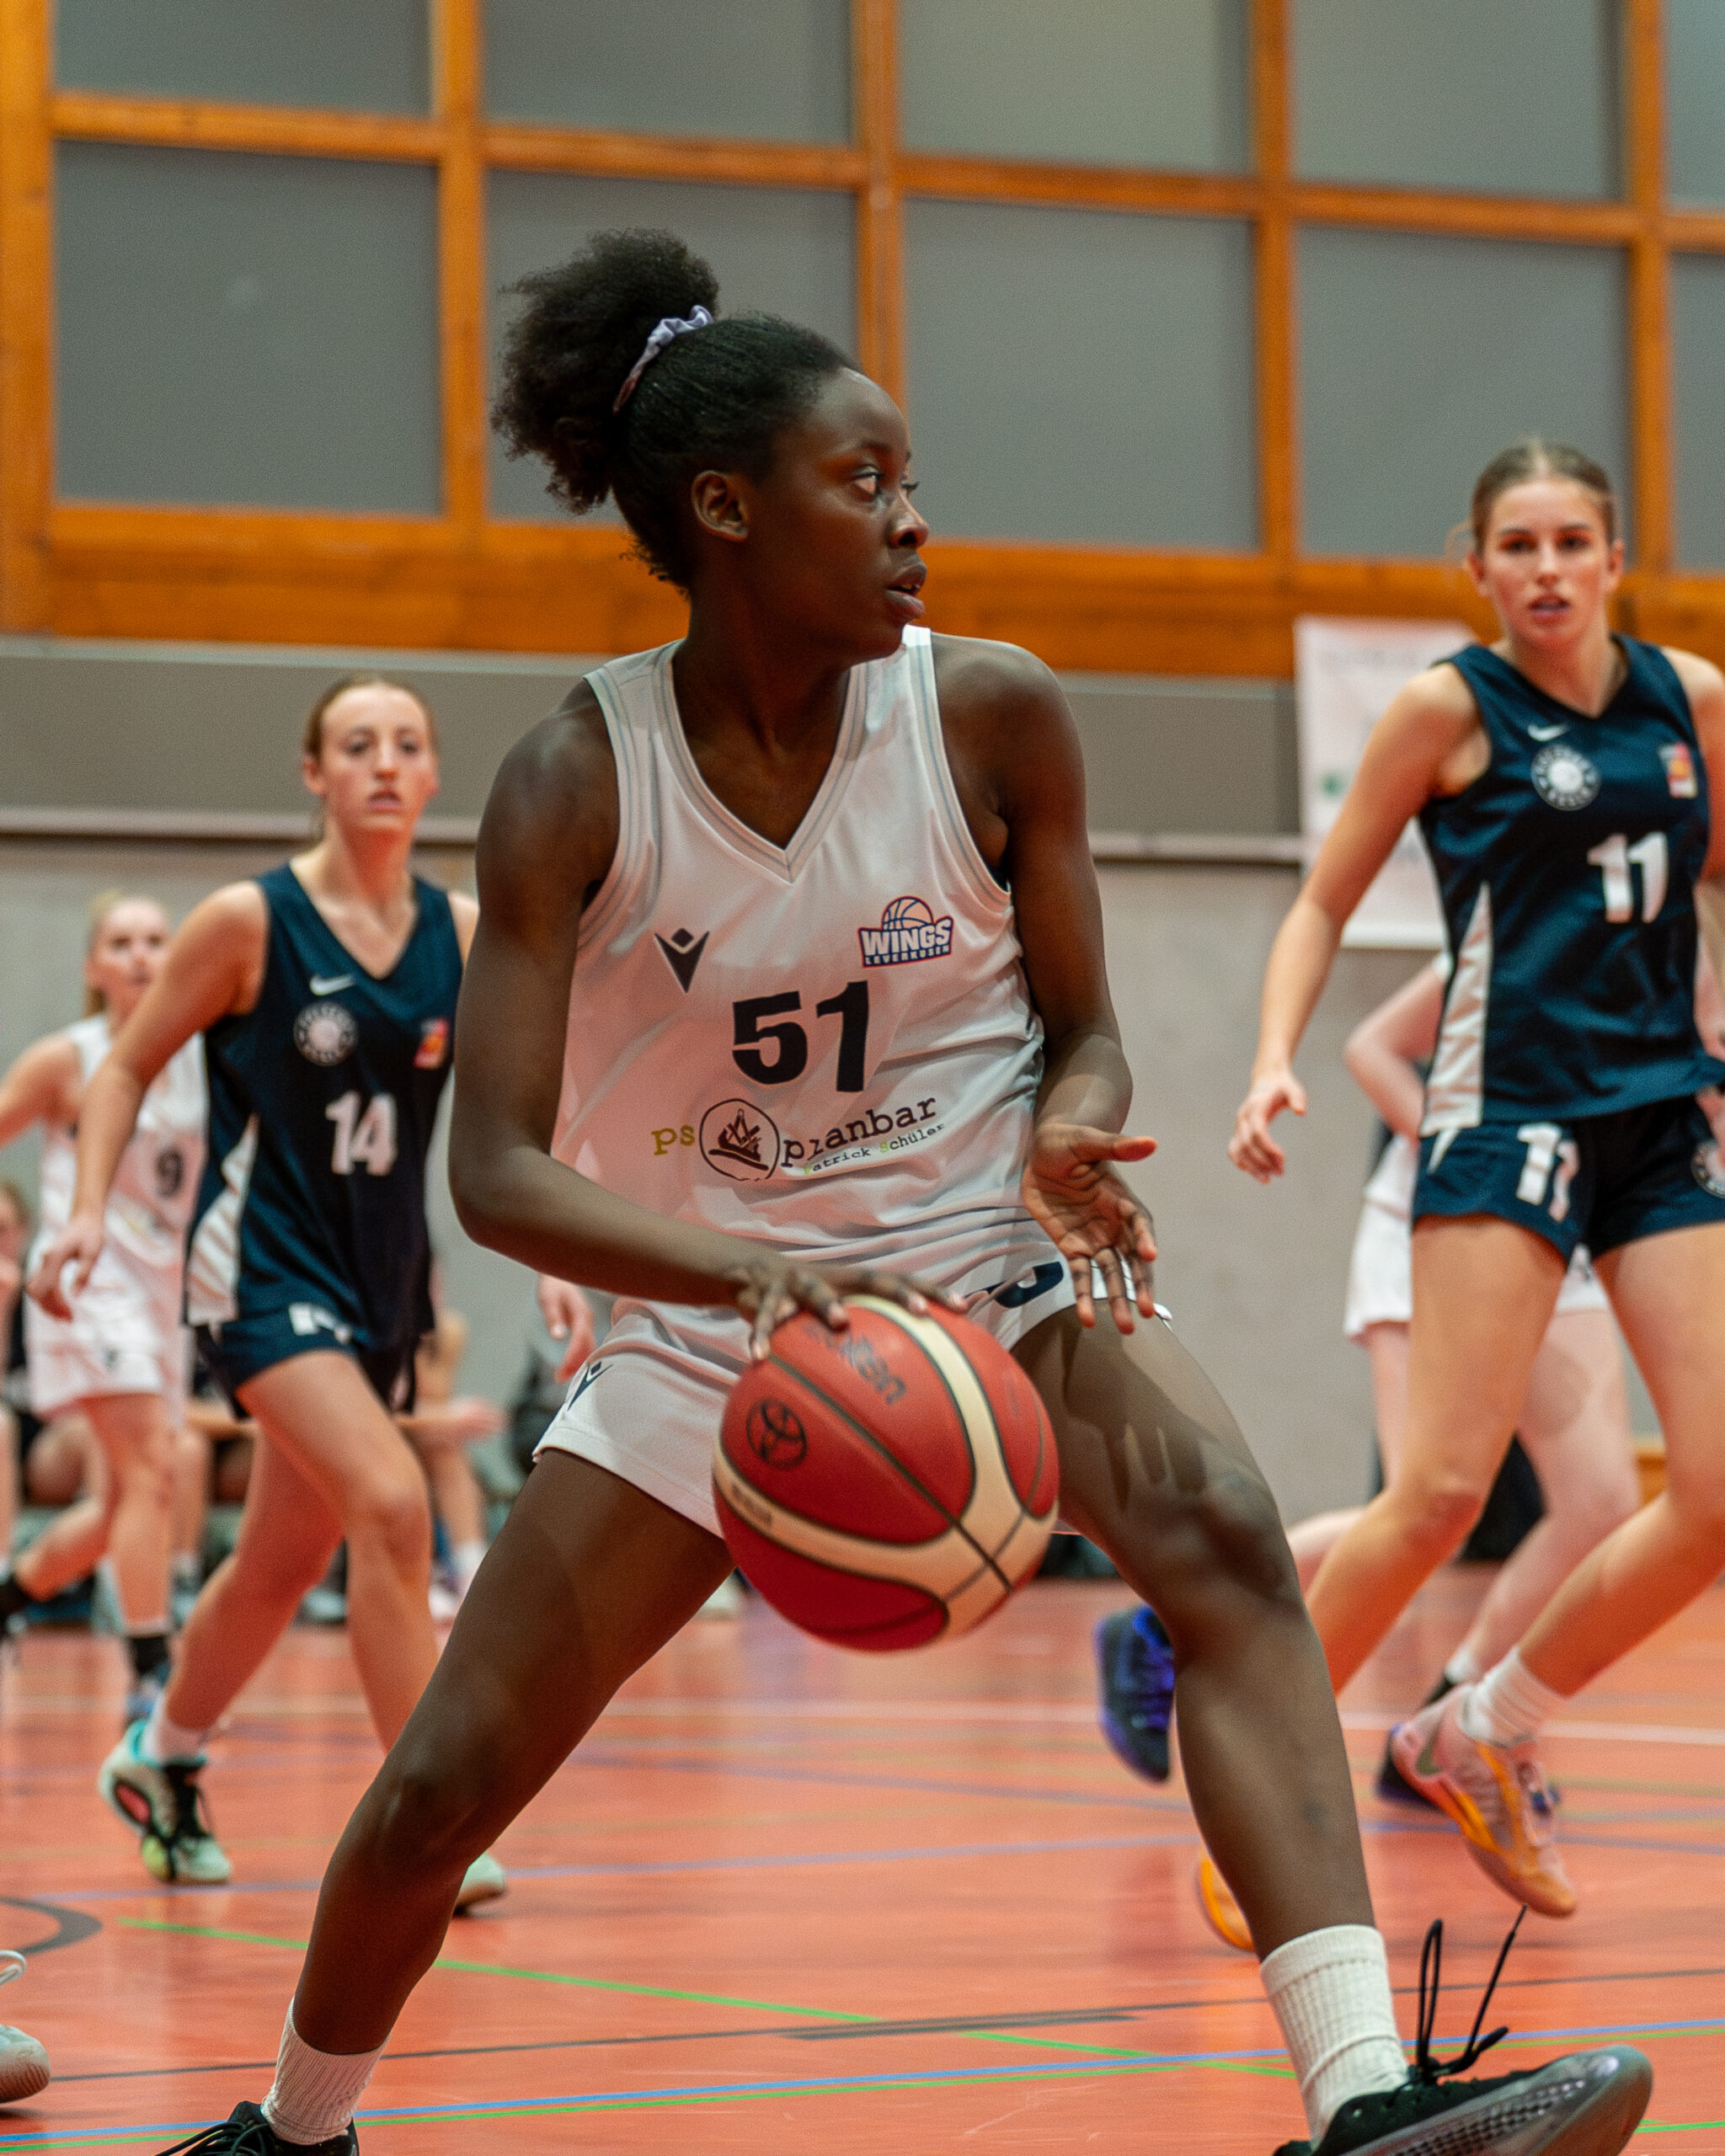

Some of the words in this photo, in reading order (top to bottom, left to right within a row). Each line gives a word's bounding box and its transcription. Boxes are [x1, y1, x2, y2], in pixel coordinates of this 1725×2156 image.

[1587, 832, 1668, 923] 11
[861, 919, 952, 955] WINGS
[732, 980, 869, 1092] 51
[325, 1091, 397, 1175] 14
[650, 1124, 695, 1155] ps
[781, 1097, 936, 1167] planbar
